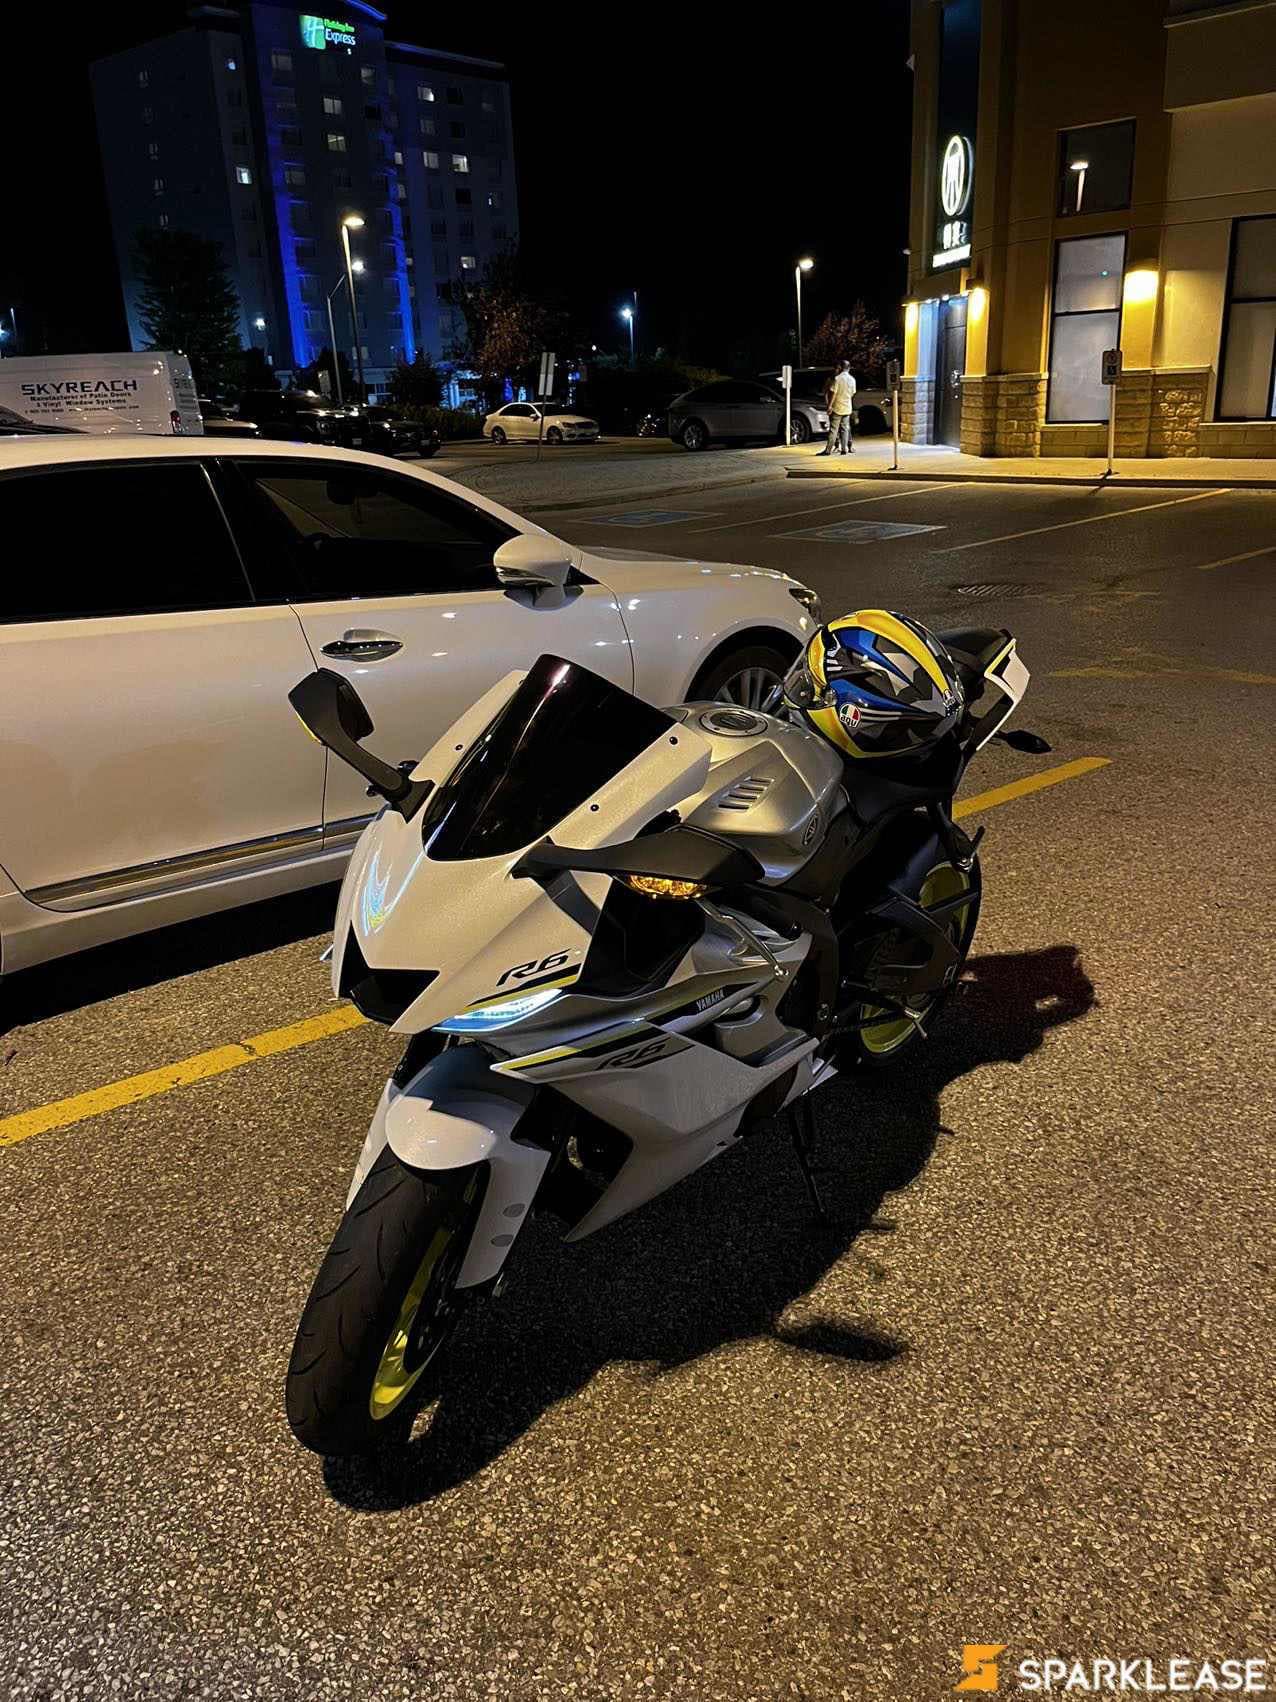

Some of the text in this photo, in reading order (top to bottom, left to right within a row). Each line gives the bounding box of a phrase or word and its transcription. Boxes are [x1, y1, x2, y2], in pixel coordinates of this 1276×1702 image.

[325, 28, 356, 45] Express
[21, 380, 136, 394] SKYREACH
[496, 948, 571, 986] R6
[696, 988, 725, 1011] YAMAHA
[595, 1036, 671, 1070] R6
